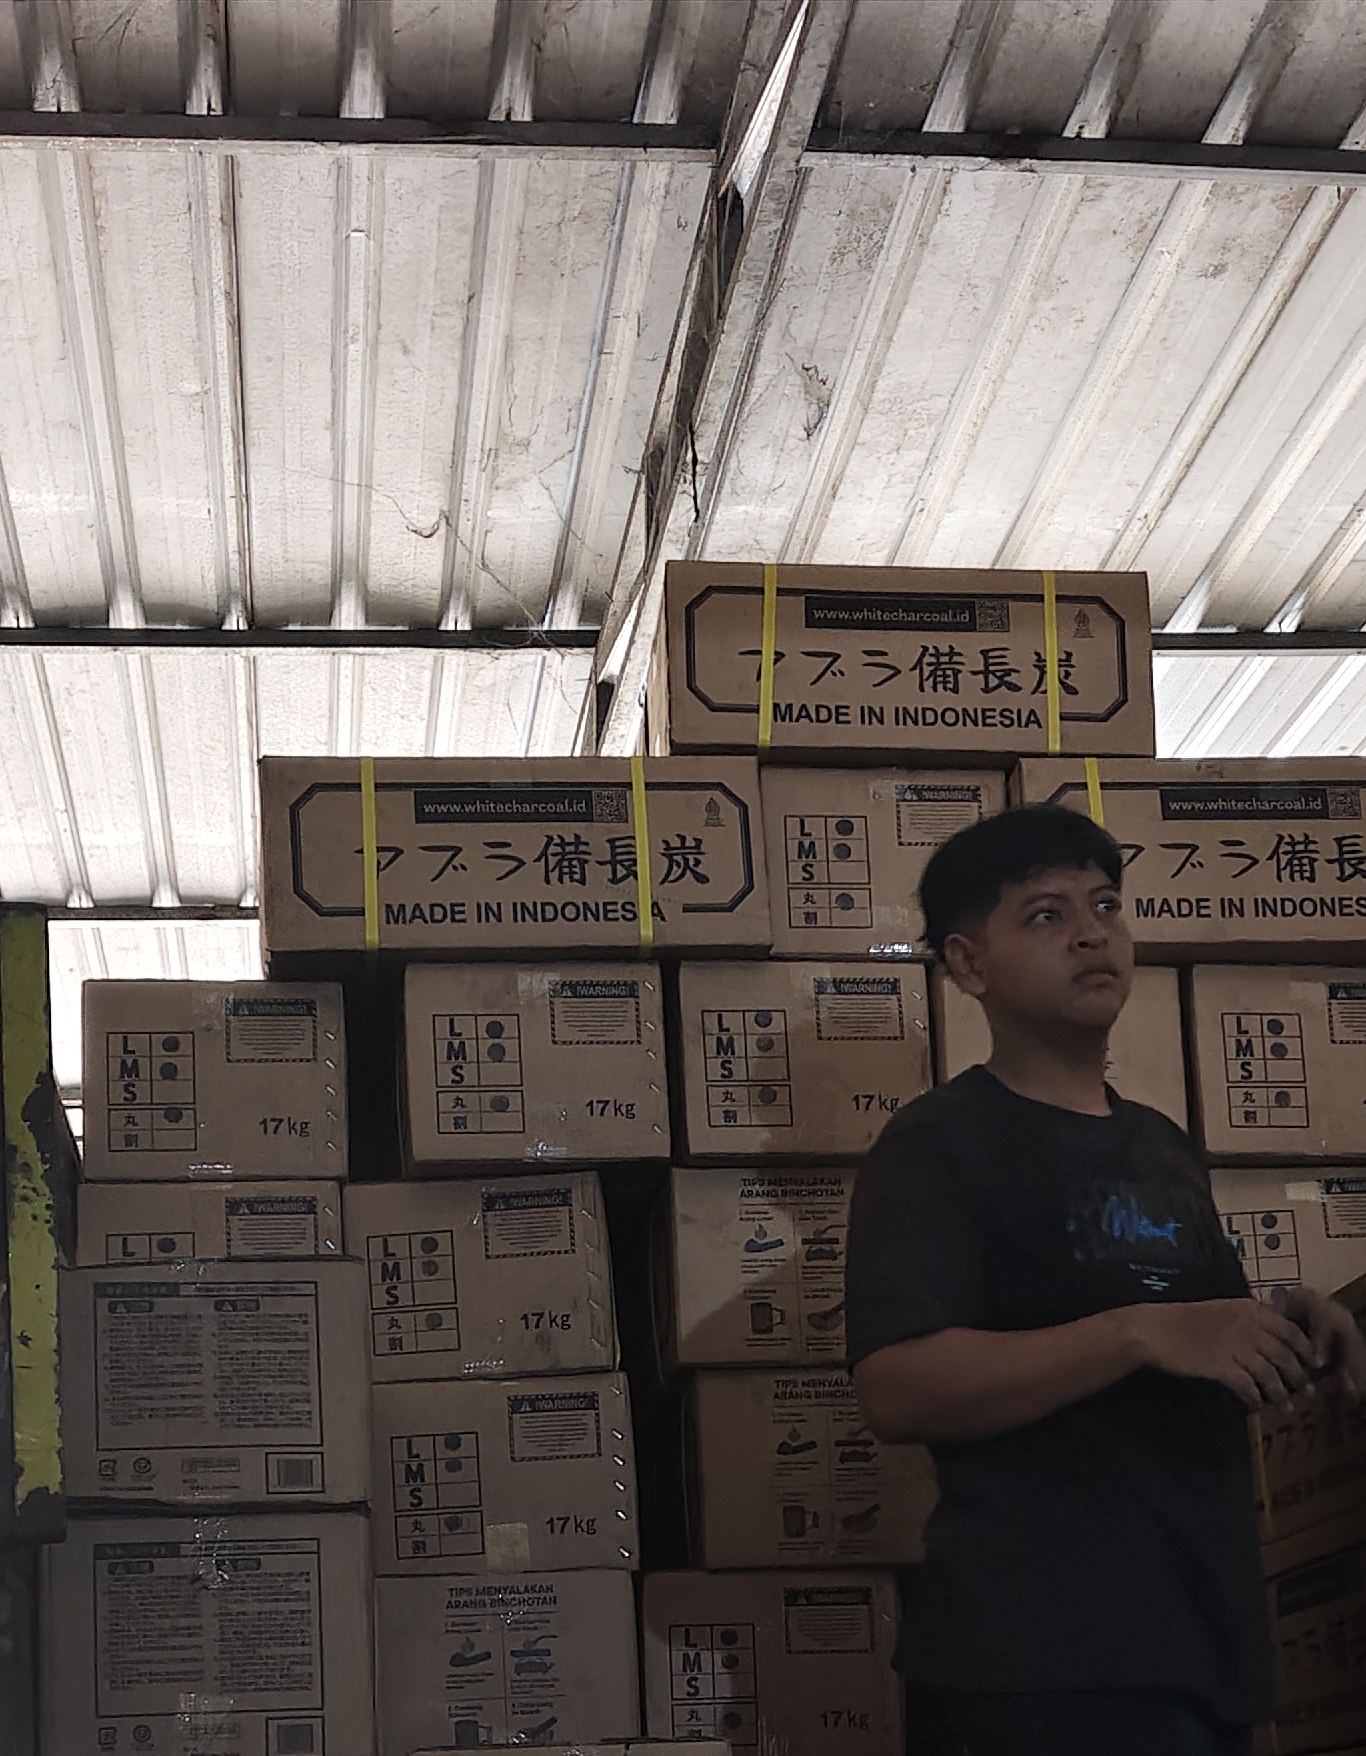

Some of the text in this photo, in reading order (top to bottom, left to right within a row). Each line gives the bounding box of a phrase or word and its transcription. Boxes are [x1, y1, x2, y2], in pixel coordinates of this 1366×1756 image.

[813, 607, 970, 623] www.whitecharcoal.id
[773, 703, 1042, 729] MADE IN INDONESIA
[423, 799, 586, 814] www.whitecharcoal.id
[1169, 797, 1324, 813] www.whitecharcoal.id
[800, 818, 812, 837] L
[798, 841, 817, 860] M
[802, 864, 814, 881] S
[385, 902, 667, 924] MADE IN INDONESA
[1136, 898, 1210, 918] MADE
[1220, 898, 1244, 918] IN
[449, 1018, 462, 1037] L
[718, 1014, 730, 1032] L
[1236, 1016, 1249, 1035] L
[122, 1036, 135, 1054] L
[447, 1041, 467, 1061] M
[716, 1036, 735, 1056] M
[1235, 1039, 1254, 1057] M
[120, 1059, 140, 1079] M
[451, 1066, 465, 1084] S
[721, 1060, 733, 1079] S
[1241, 1062, 1253, 1080] S
[123, 1083, 137, 1102] S
[122, 1237, 135, 1256] L
[383, 1238, 395, 1257] L
[381, 1262, 401, 1282] M
[385, 1286, 399, 1305] S
[407, 1439, 419, 1458] L
[405, 1464, 425, 1483] M
[410, 1488, 423, 1508] S
[684, 1628, 698, 1648] L
[682, 1652, 702, 1672] M
[687, 1676, 700, 1696] S
